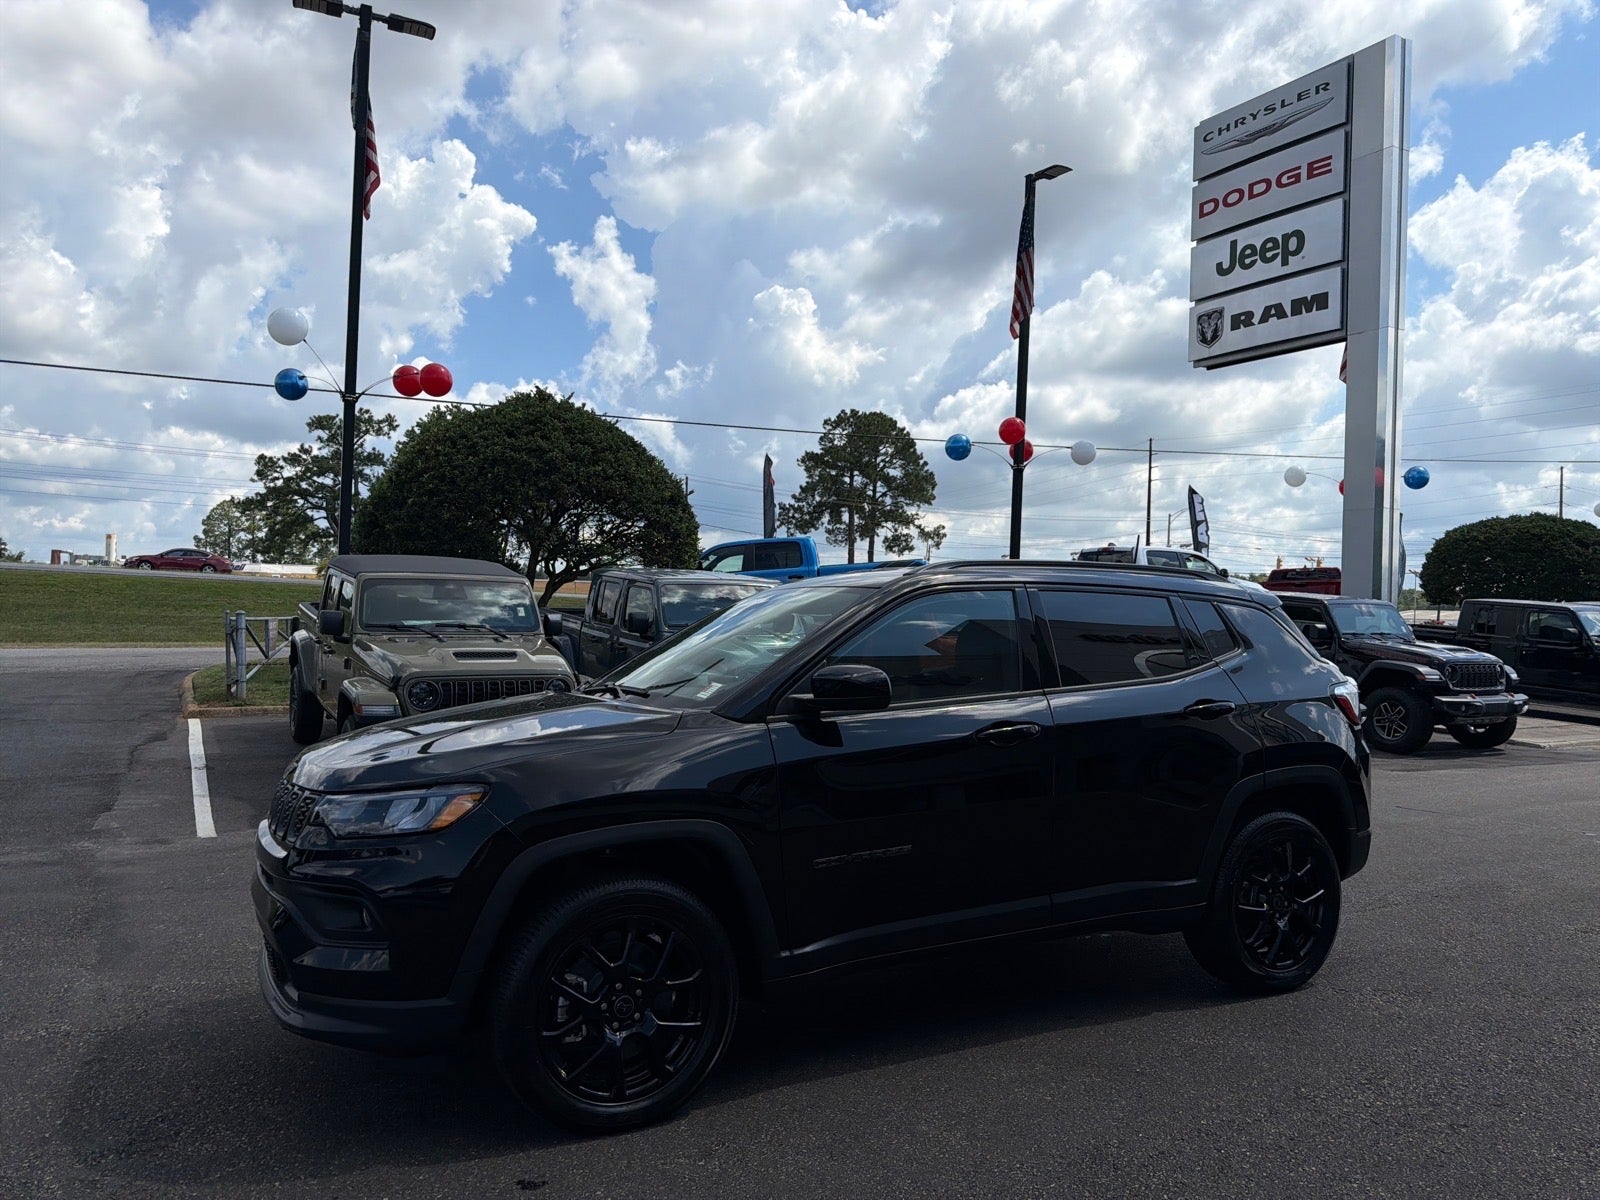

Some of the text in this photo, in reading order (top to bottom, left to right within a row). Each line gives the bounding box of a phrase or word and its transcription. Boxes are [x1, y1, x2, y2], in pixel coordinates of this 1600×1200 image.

[1202, 81, 1331, 143] CHRYSLER
[1198, 154, 1333, 220] DODGE
[1215, 228, 1306, 277] Jeep
[1230, 291, 1329, 331] RAM
